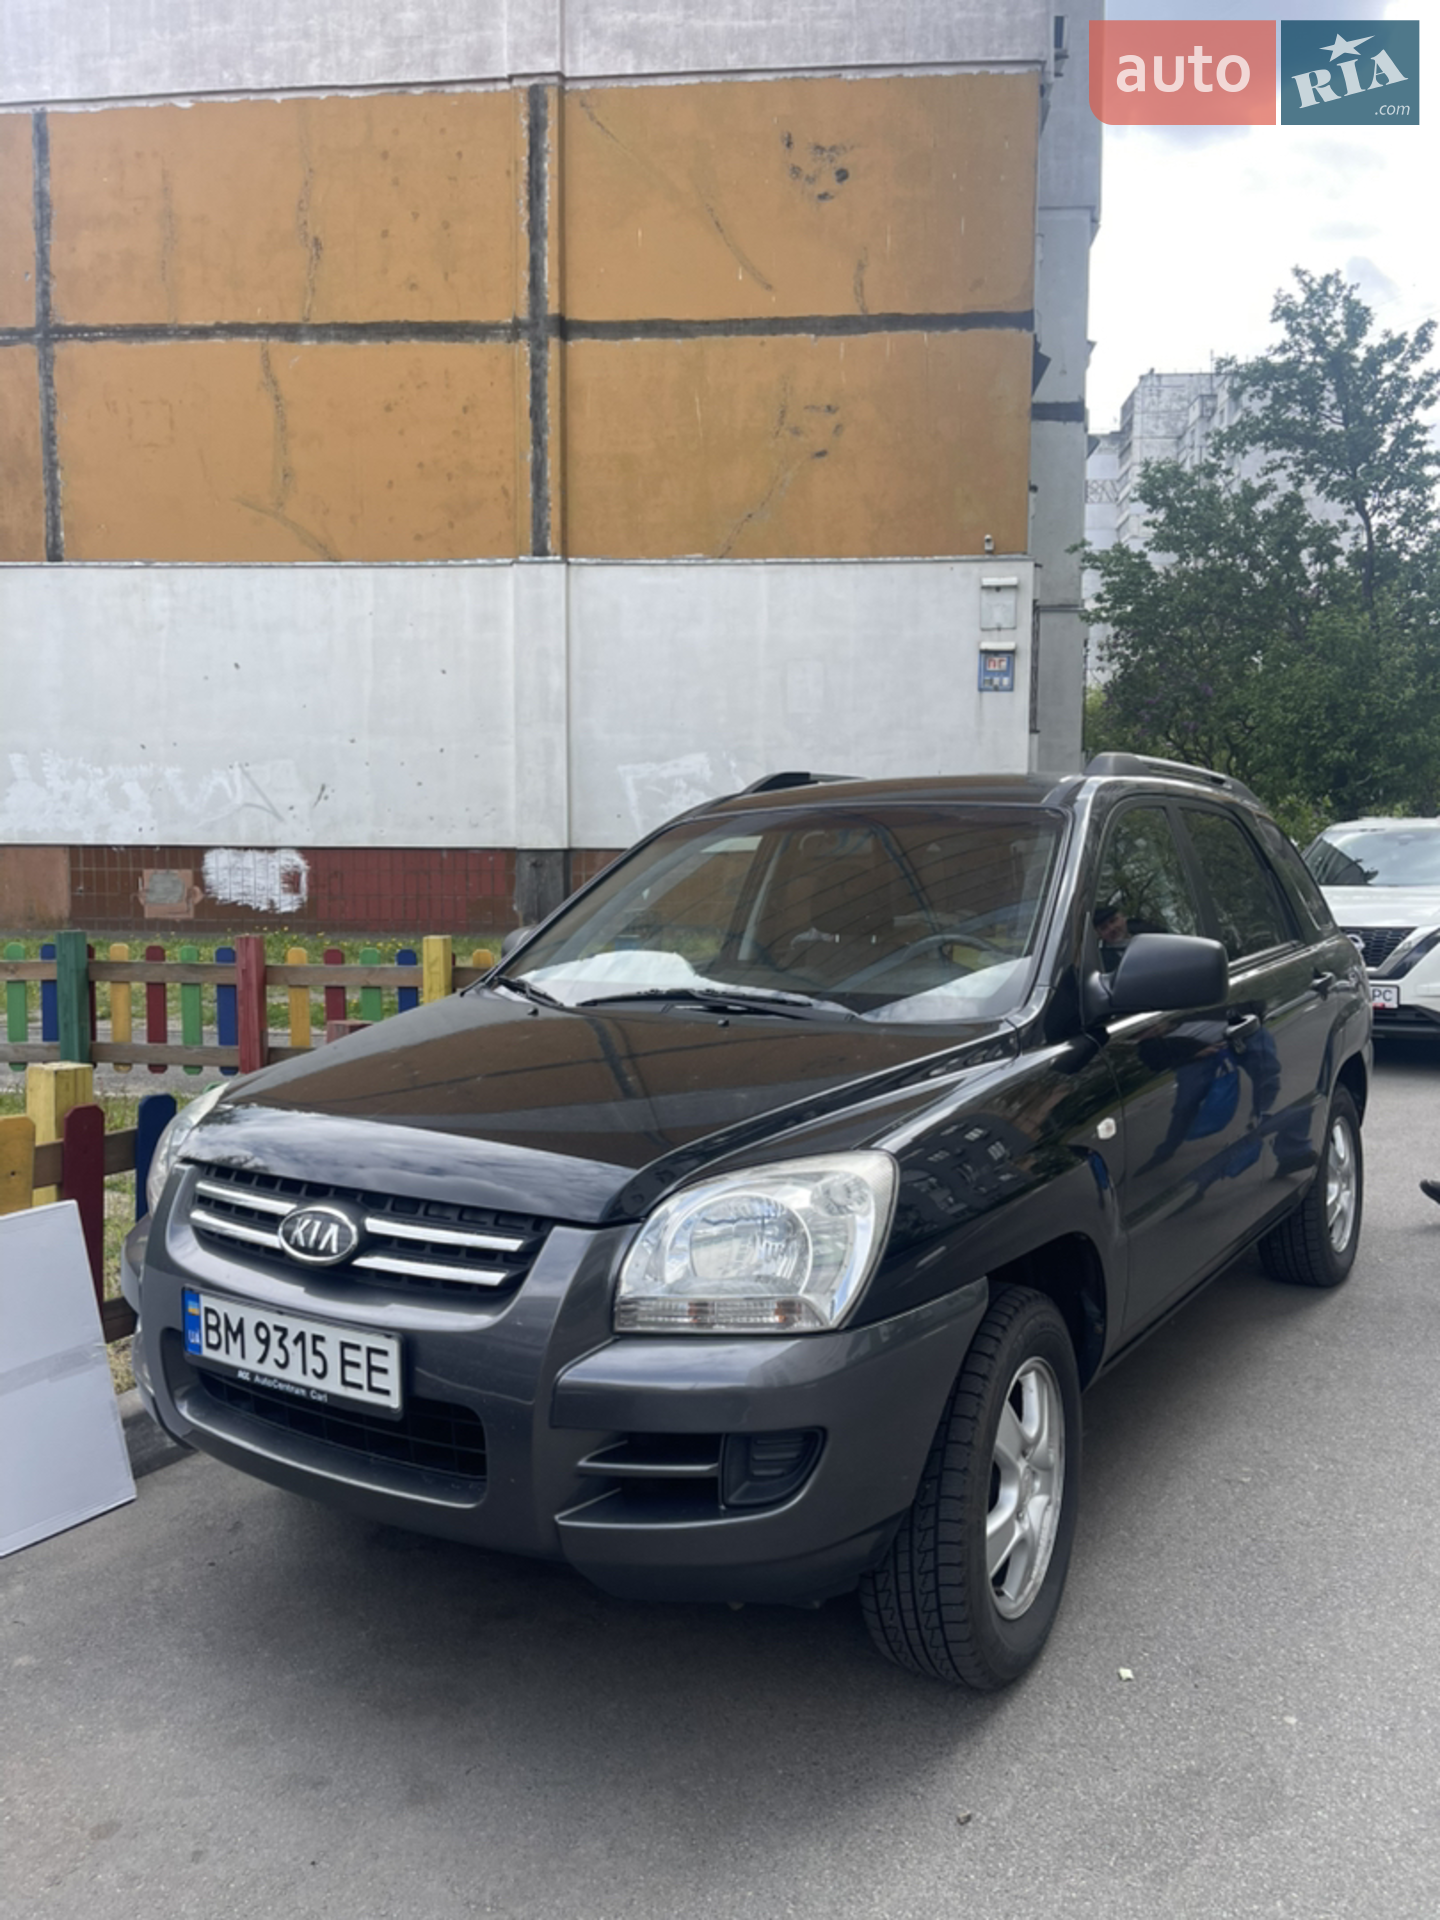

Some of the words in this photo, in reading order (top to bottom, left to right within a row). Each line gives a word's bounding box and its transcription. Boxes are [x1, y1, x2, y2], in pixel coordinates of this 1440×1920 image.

[290, 1217, 339, 1253] KIA
[204, 1306, 246, 1360] BM
[254, 1321, 328, 1380] 9315
[340, 1340, 391, 1397] EE
